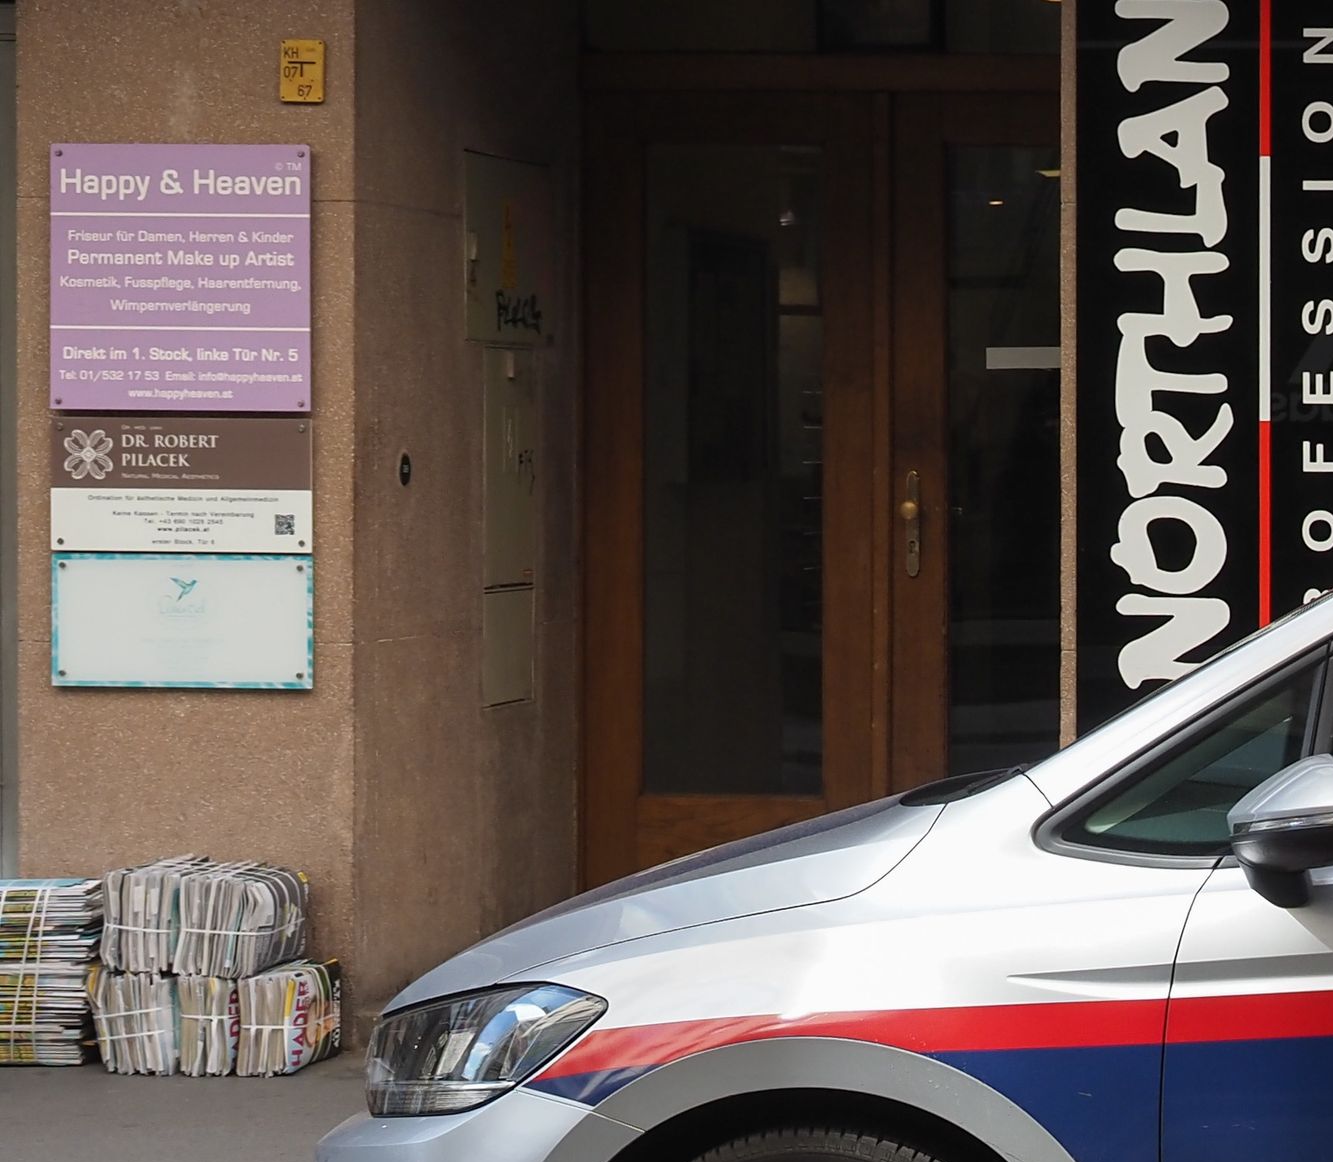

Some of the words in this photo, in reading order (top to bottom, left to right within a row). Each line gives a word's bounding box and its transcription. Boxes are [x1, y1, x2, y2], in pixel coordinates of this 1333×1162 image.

[283, 46, 299, 59] KH
[283, 65, 299, 78] 07
[297, 84, 312, 97] 67
[286, 162, 302, 171] TM
[60, 168, 150, 200] Happy
[160, 169, 184, 194] &
[193, 169, 301, 195] Heaven
[67, 230, 113, 242] Friseur
[116, 230, 135, 242] für
[138, 231, 185, 244] Damen,
[189, 231, 234, 243] Herren
[238, 232, 249, 243] &
[252, 231, 294, 244] Kinder
[67, 249, 163, 265] Permanent
[168, 250, 214, 266] Make
[219, 253, 240, 269] up
[245, 251, 295, 267] Artist
[59, 276, 121, 289] Kosmetik,
[124, 276, 194, 291] Fusspflege,
[198, 277, 302, 292] Haarentfernung,
[110, 299, 251, 315] Wimpernverlängerung
[62, 346, 107, 360] Direkt
[109, 347, 127, 360] im
[132, 347, 146, 361] 1.
[149, 347, 193, 362] Stock,
[196, 347, 229, 362] linke
[232, 348, 258, 362] Tür
[262, 348, 284, 362] Nr.
[288, 348, 299, 362] 5
[79, 370, 125, 382] 01/532
[127, 371, 142, 381] 17
[144, 370, 160, 381] 53
[128, 388, 233, 400] www.happyheaven.at
[154, 434, 219, 448] ROBERT
[121, 453, 190, 467] PILACEK
